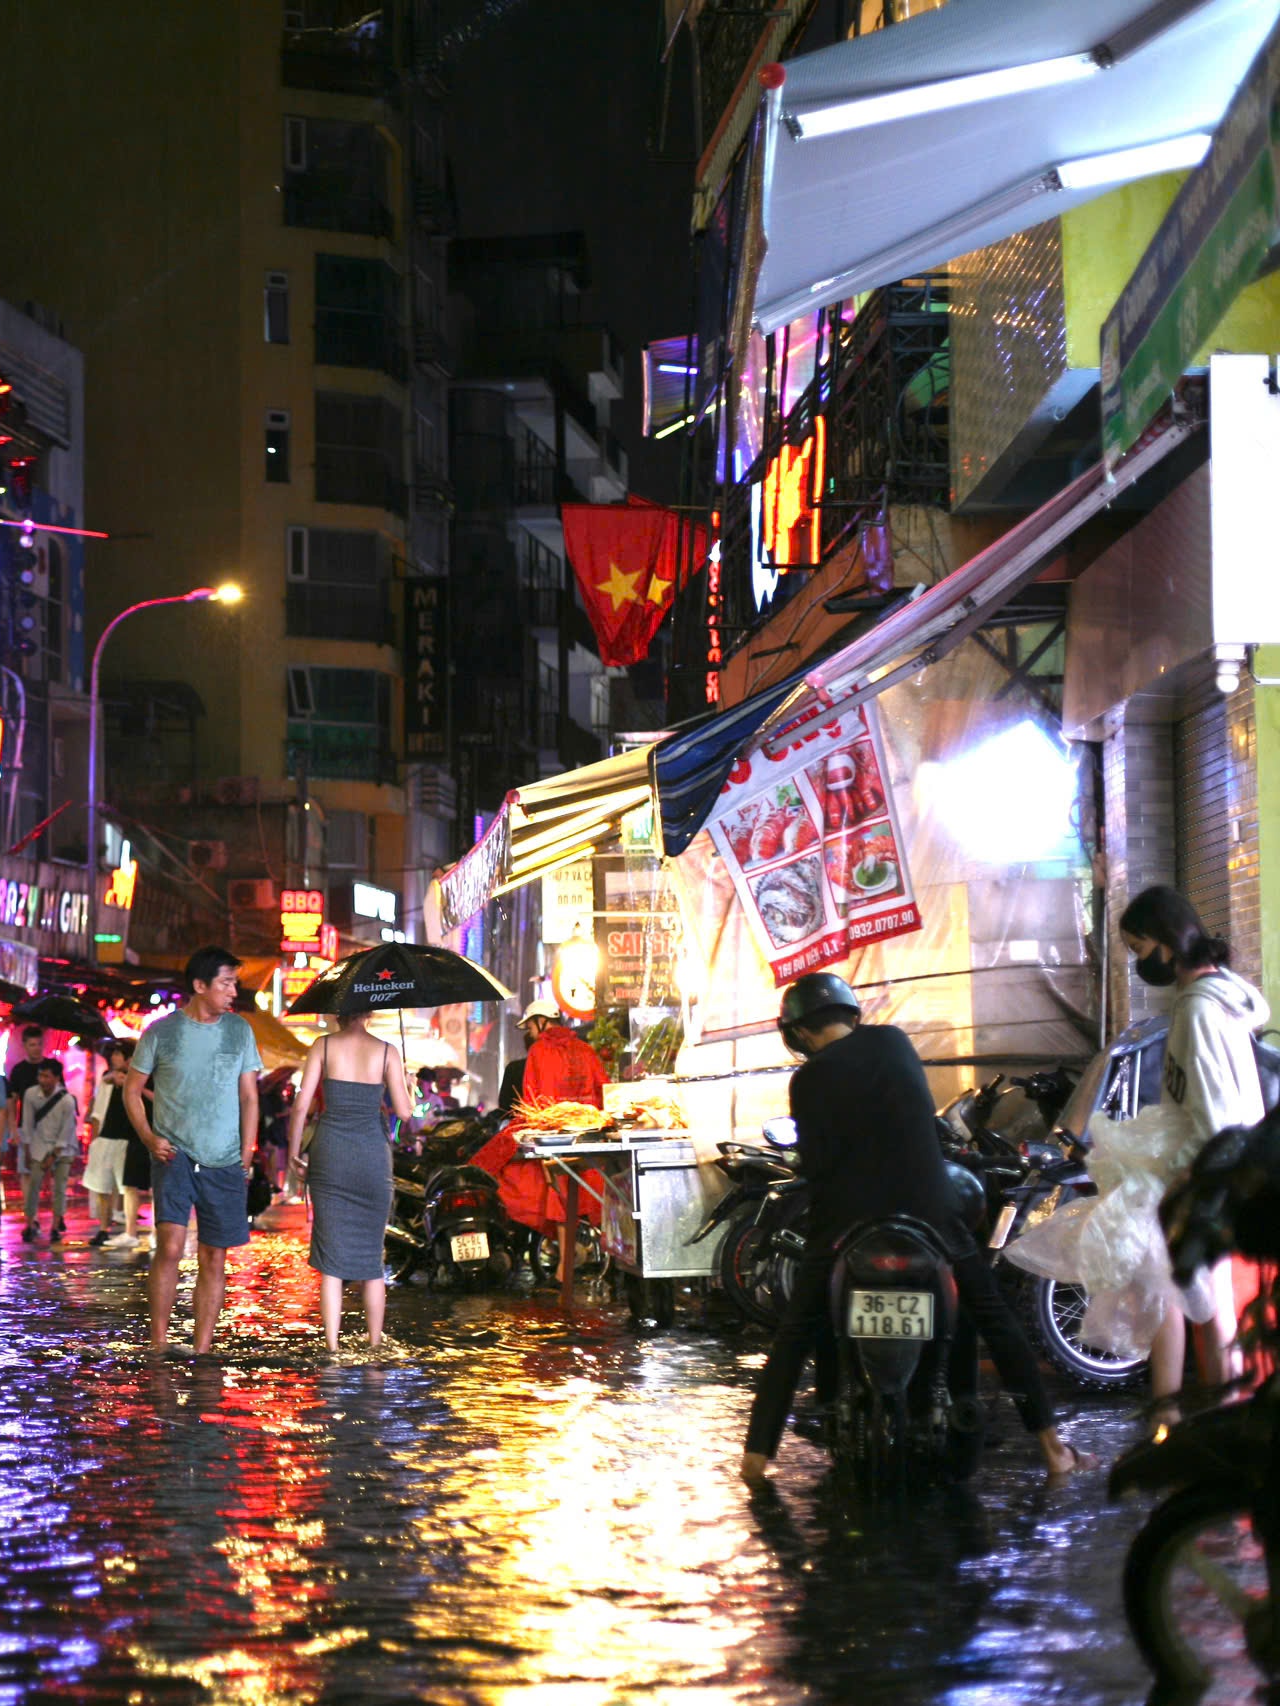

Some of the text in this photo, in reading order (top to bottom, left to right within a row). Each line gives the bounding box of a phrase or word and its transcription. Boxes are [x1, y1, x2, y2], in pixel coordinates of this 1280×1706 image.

[414, 587, 437, 725] MERAKI
[281, 891, 323, 912] BBQ
[354, 980, 415, 993] Heineken
[370, 992, 394, 1003] 007
[856, 1315, 926, 1336] 118.61
